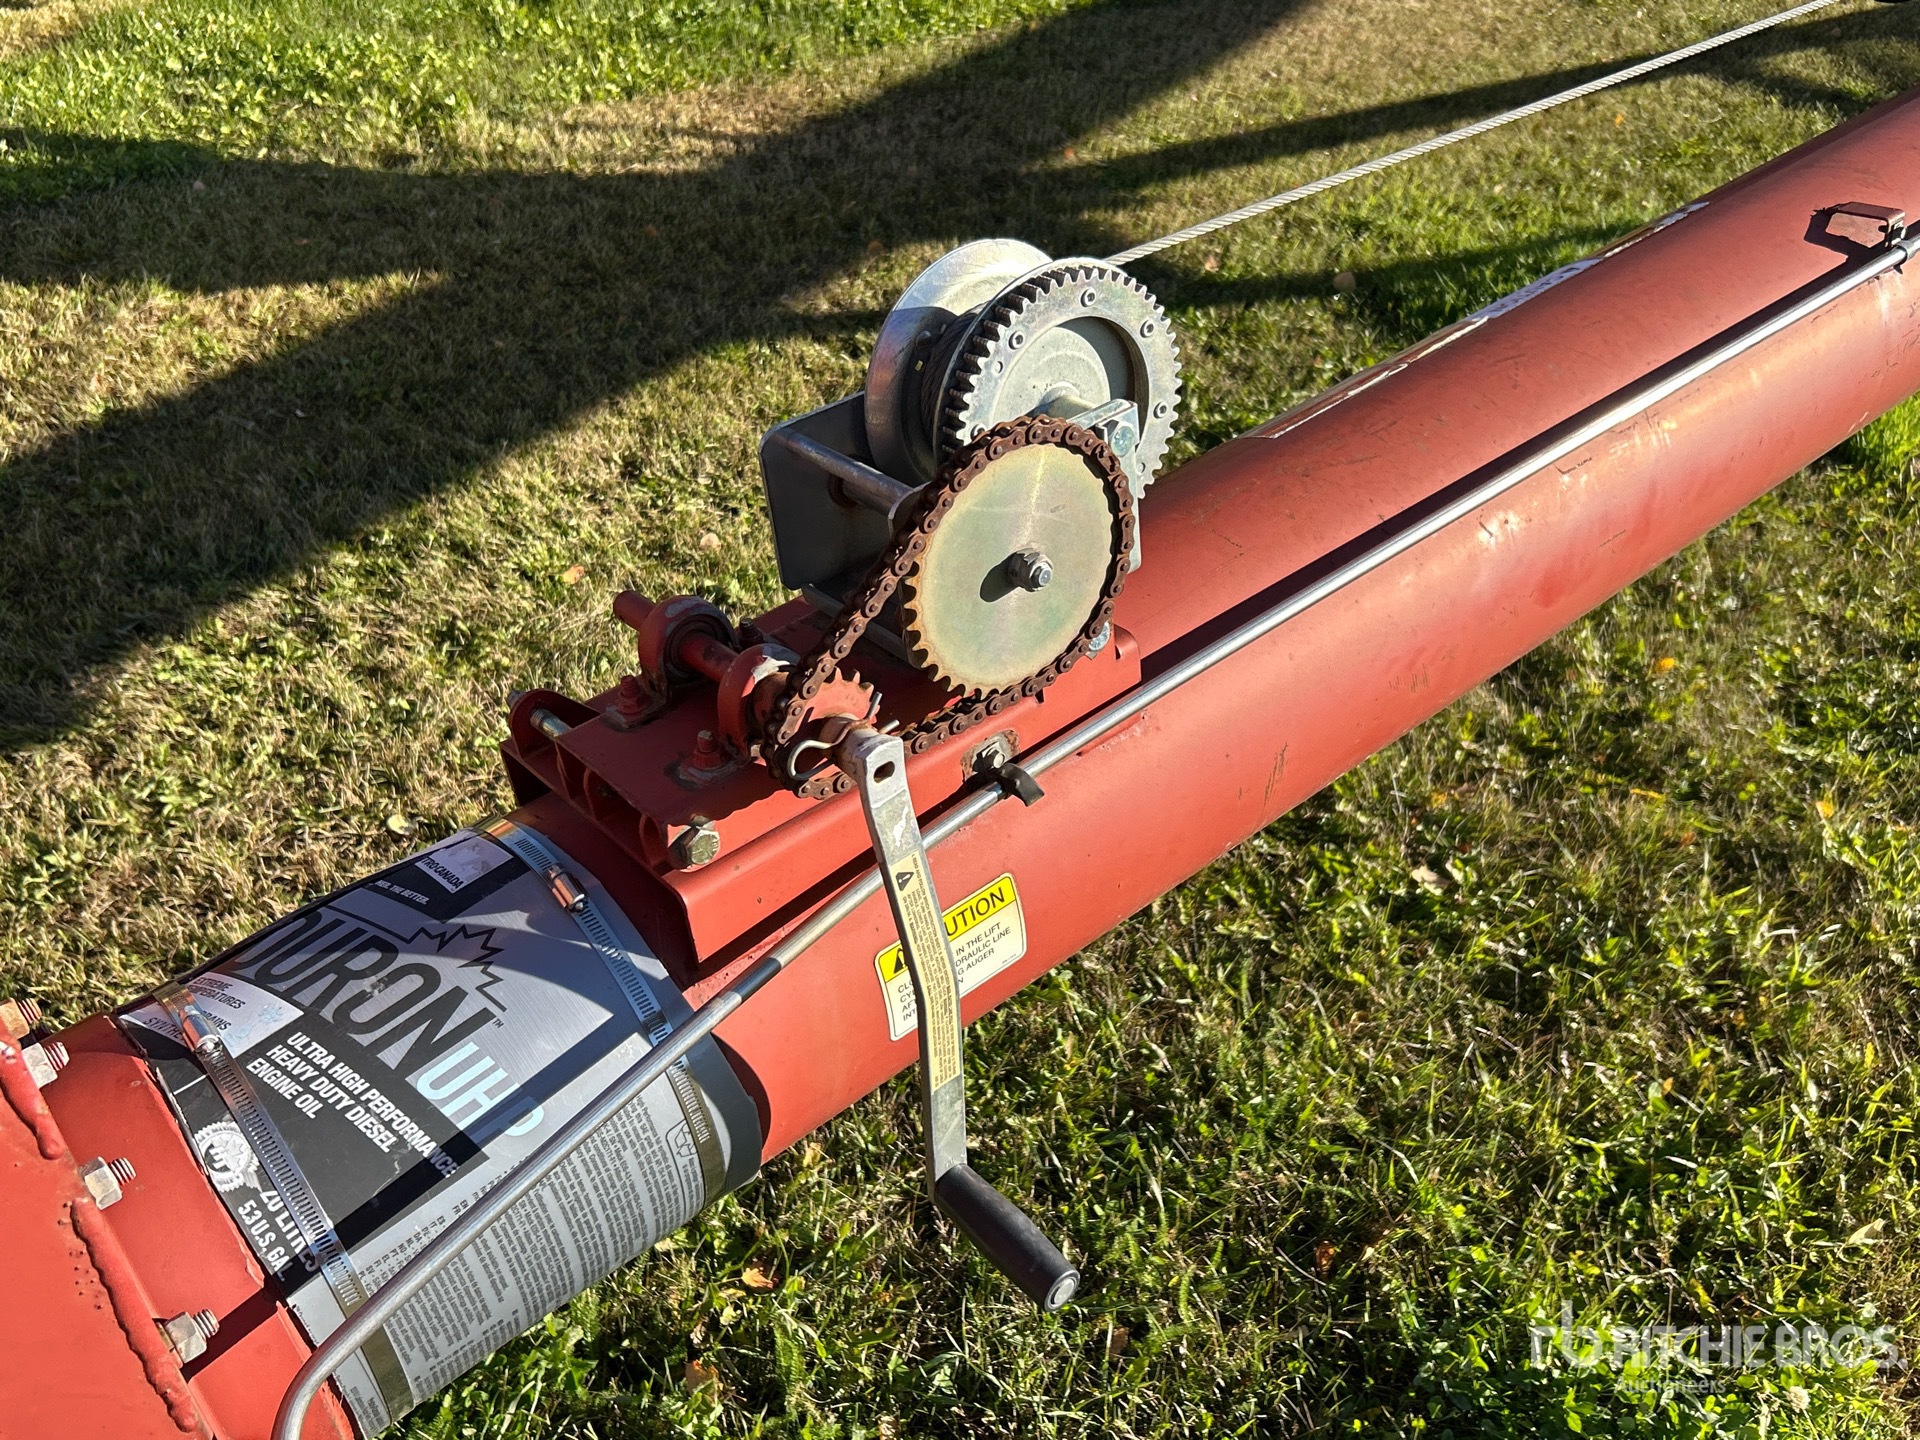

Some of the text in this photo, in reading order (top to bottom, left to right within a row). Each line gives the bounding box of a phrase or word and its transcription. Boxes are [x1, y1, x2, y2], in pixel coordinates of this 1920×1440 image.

[944, 887, 1005, 936] UTION
[955, 945, 965, 956] IN
[966, 934, 983, 949] THE
[984, 922, 1001, 938] LIFT
[955, 940, 992, 967] DRAULIC
[993, 926, 1011, 943] LINE
[966, 948, 995, 971] AUGER
[246, 1058, 324, 1119] ENGINE OIL
[267, 1045, 398, 1153] HEAVY DUTY DIESEL
[287, 1032, 459, 1178] ULTRA HIGH PERFORMANCE
[417, 1042, 544, 1137] UHP
